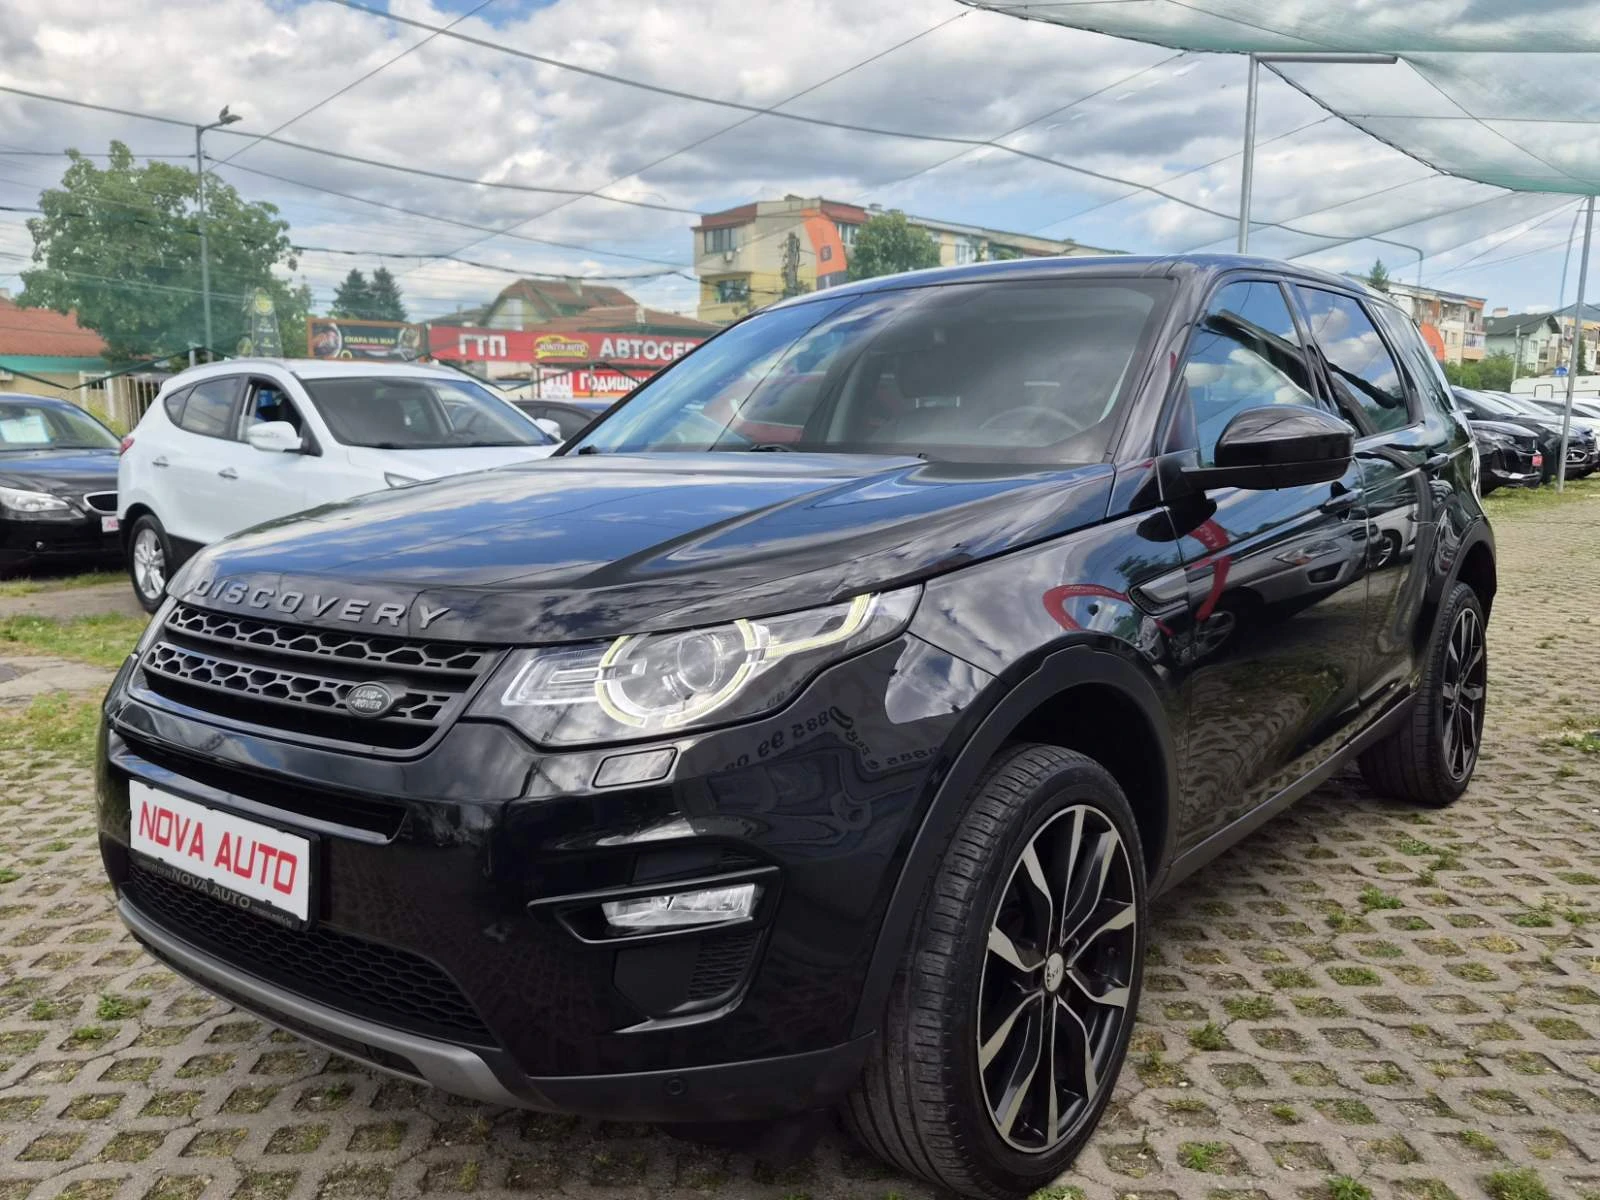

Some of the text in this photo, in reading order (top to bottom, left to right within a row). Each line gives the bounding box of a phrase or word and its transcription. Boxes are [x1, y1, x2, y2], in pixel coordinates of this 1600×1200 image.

[459, 333, 507, 357] ГТП
[194, 578, 450, 629] DISCOVERY
[139, 800, 298, 896] NOVA AUTO
[171, 868, 210, 895] NOVA
[211, 886, 251, 909] AUTO
